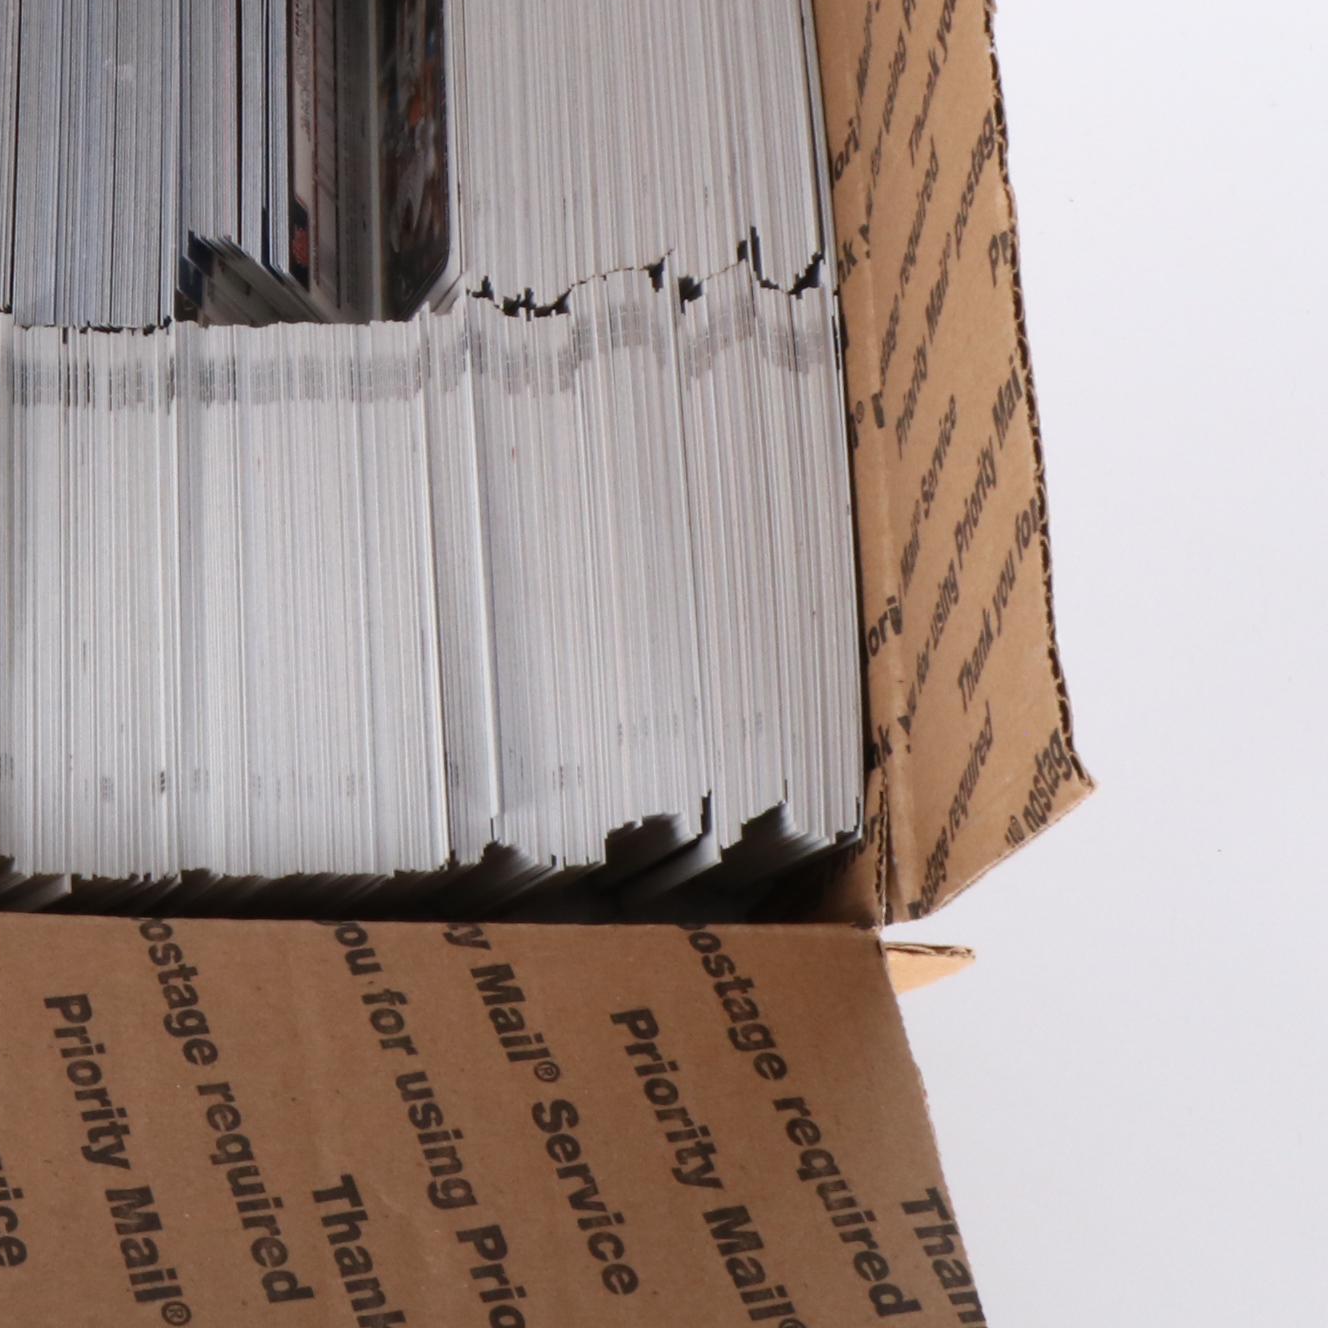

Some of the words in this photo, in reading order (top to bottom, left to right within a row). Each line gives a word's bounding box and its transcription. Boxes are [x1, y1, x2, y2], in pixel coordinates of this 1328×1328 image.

[43, 994, 131, 1171] Priority
[105, 1184, 192, 1326] Mail®
[138, 918, 218, 1065] ostage
[196, 1081, 315, 1304] required
[361, 988, 419, 1056] for
[395, 1071, 478, 1210] using
[470, 964, 560, 1083] Mail®
[531, 1099, 639, 1296] Service
[610, 1007, 723, 1189] Priority
[772, 1096, 924, 1317] required
